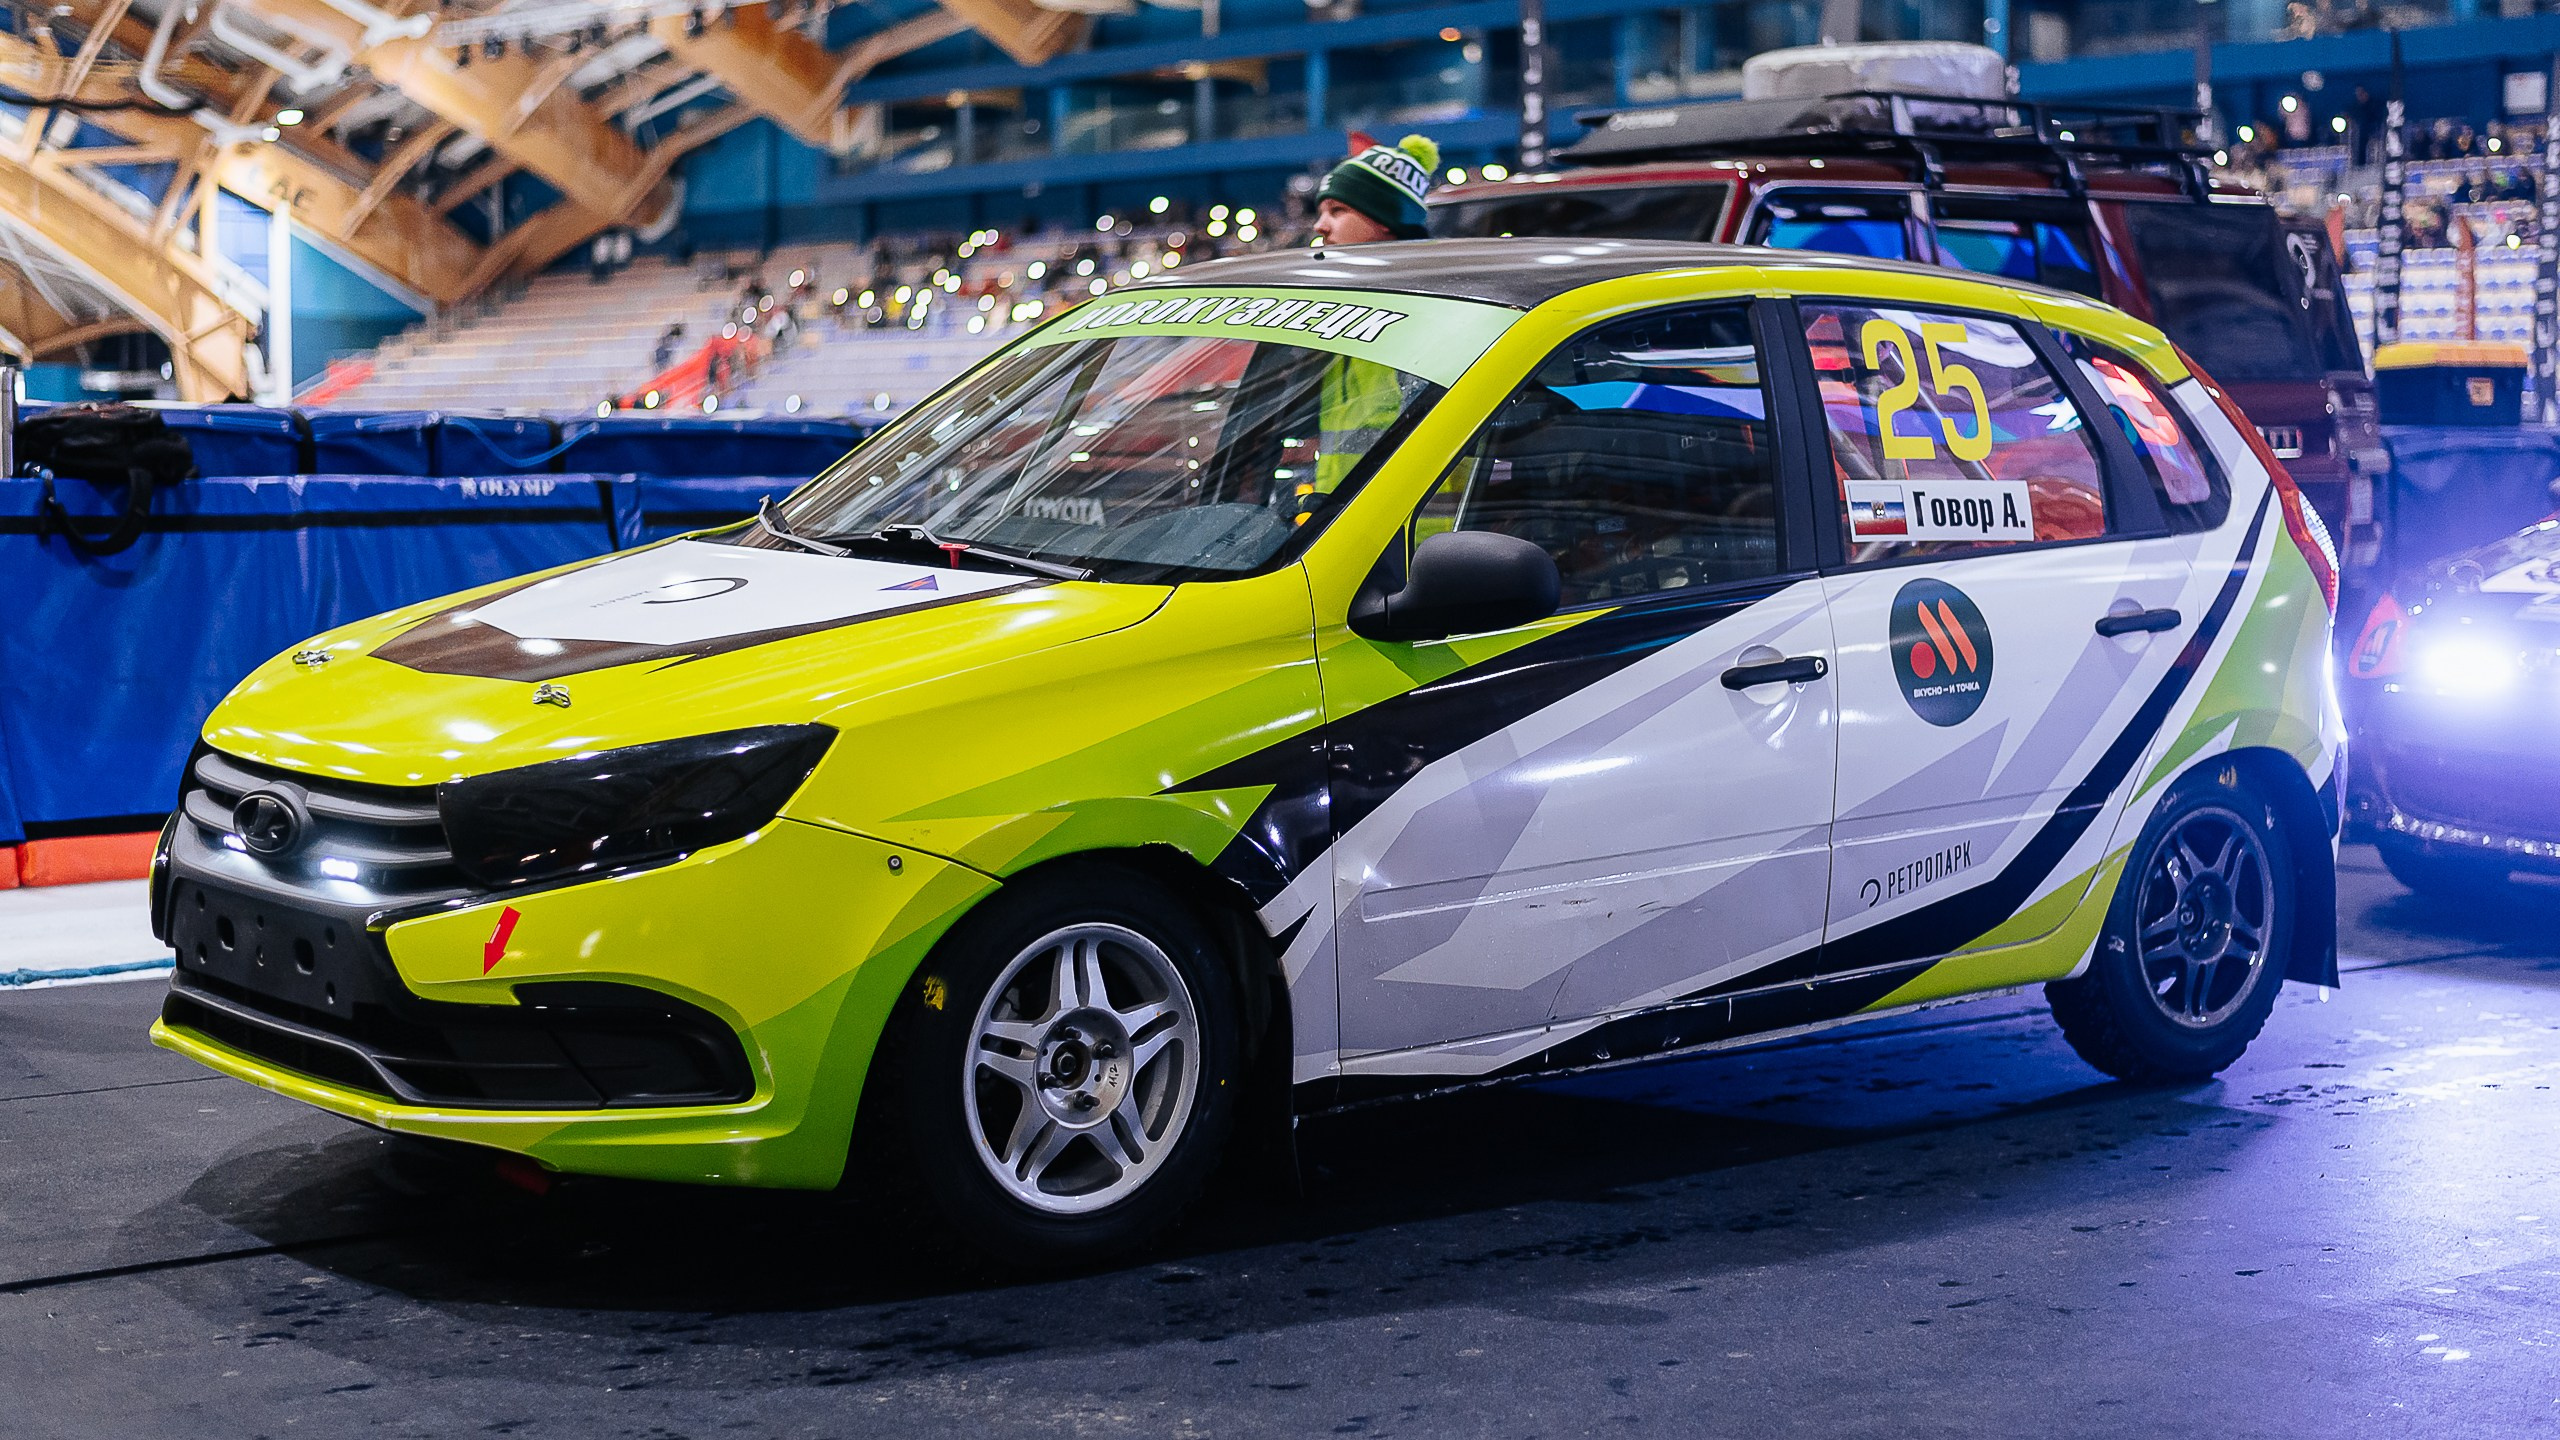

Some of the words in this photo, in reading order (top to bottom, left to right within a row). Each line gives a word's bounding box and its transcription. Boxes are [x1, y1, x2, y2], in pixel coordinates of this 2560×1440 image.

[1372, 153, 1430, 198] RALLY
[1060, 296, 1408, 343] НОВОКУЗНЕЦК
[1861, 319, 1992, 461] 25
[479, 479, 556, 497] OLYMP
[1912, 491, 1994, 534] Говор
[2003, 492, 2026, 528] А.
[1888, 840, 1971, 899] РЕТРОПАРК
